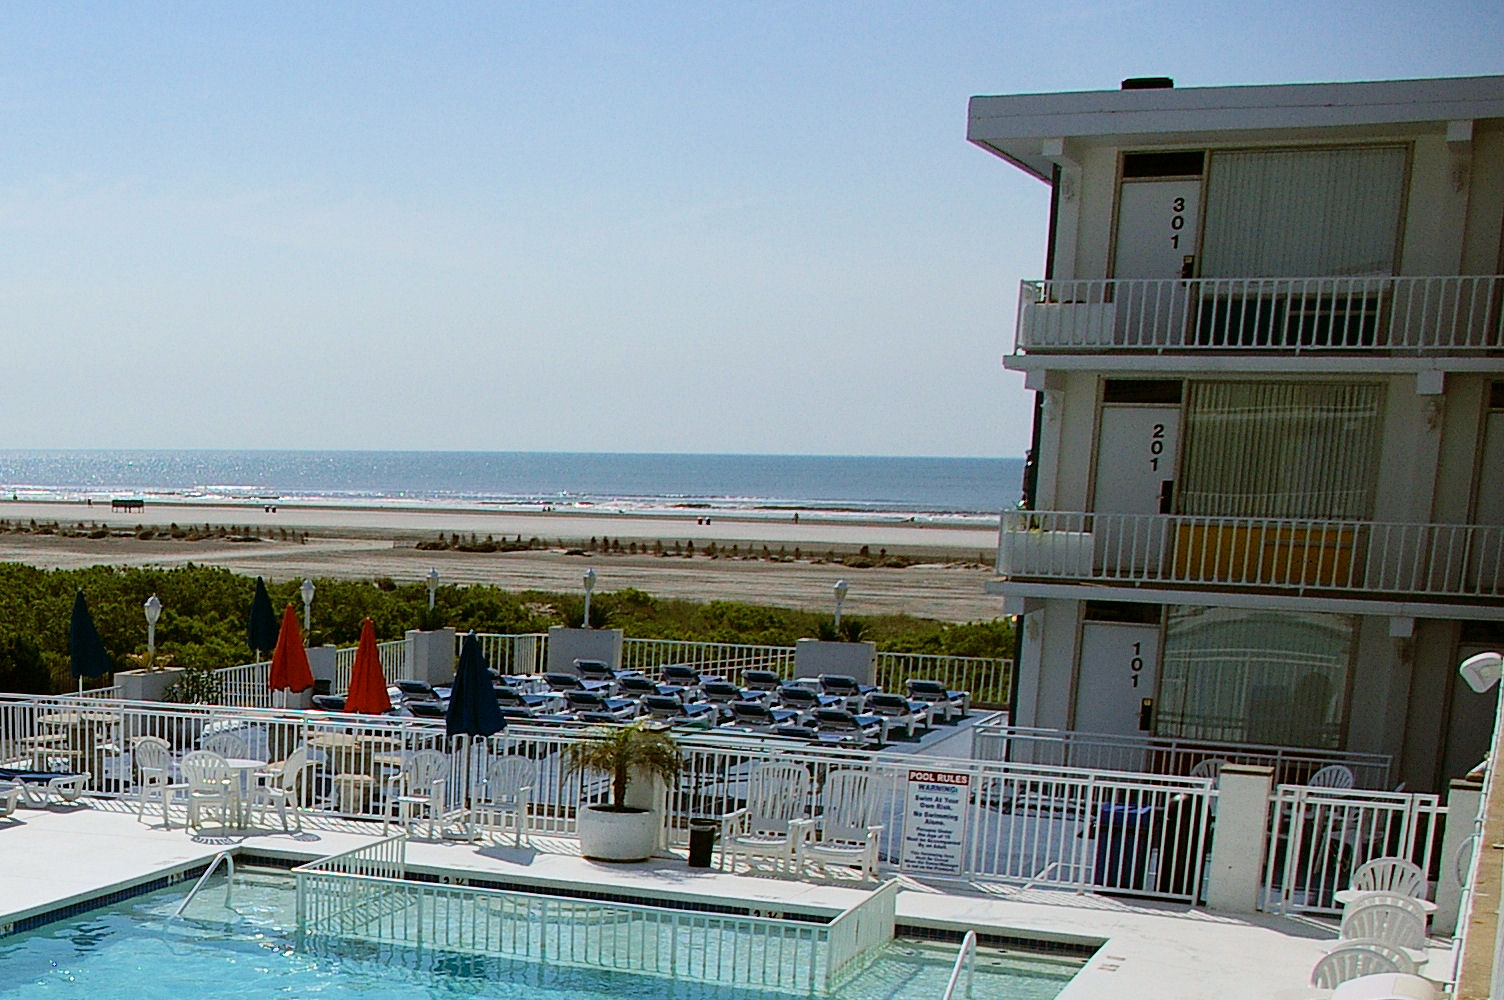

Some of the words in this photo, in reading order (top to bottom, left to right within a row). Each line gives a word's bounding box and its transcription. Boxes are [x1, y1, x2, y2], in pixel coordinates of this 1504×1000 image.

[1170, 197, 1185, 250] 301
[1150, 423, 1165, 472] 201
[1131, 641, 1143, 688] 101
[910, 772, 935, 781] POOL
[937, 774, 967, 784] RULES
